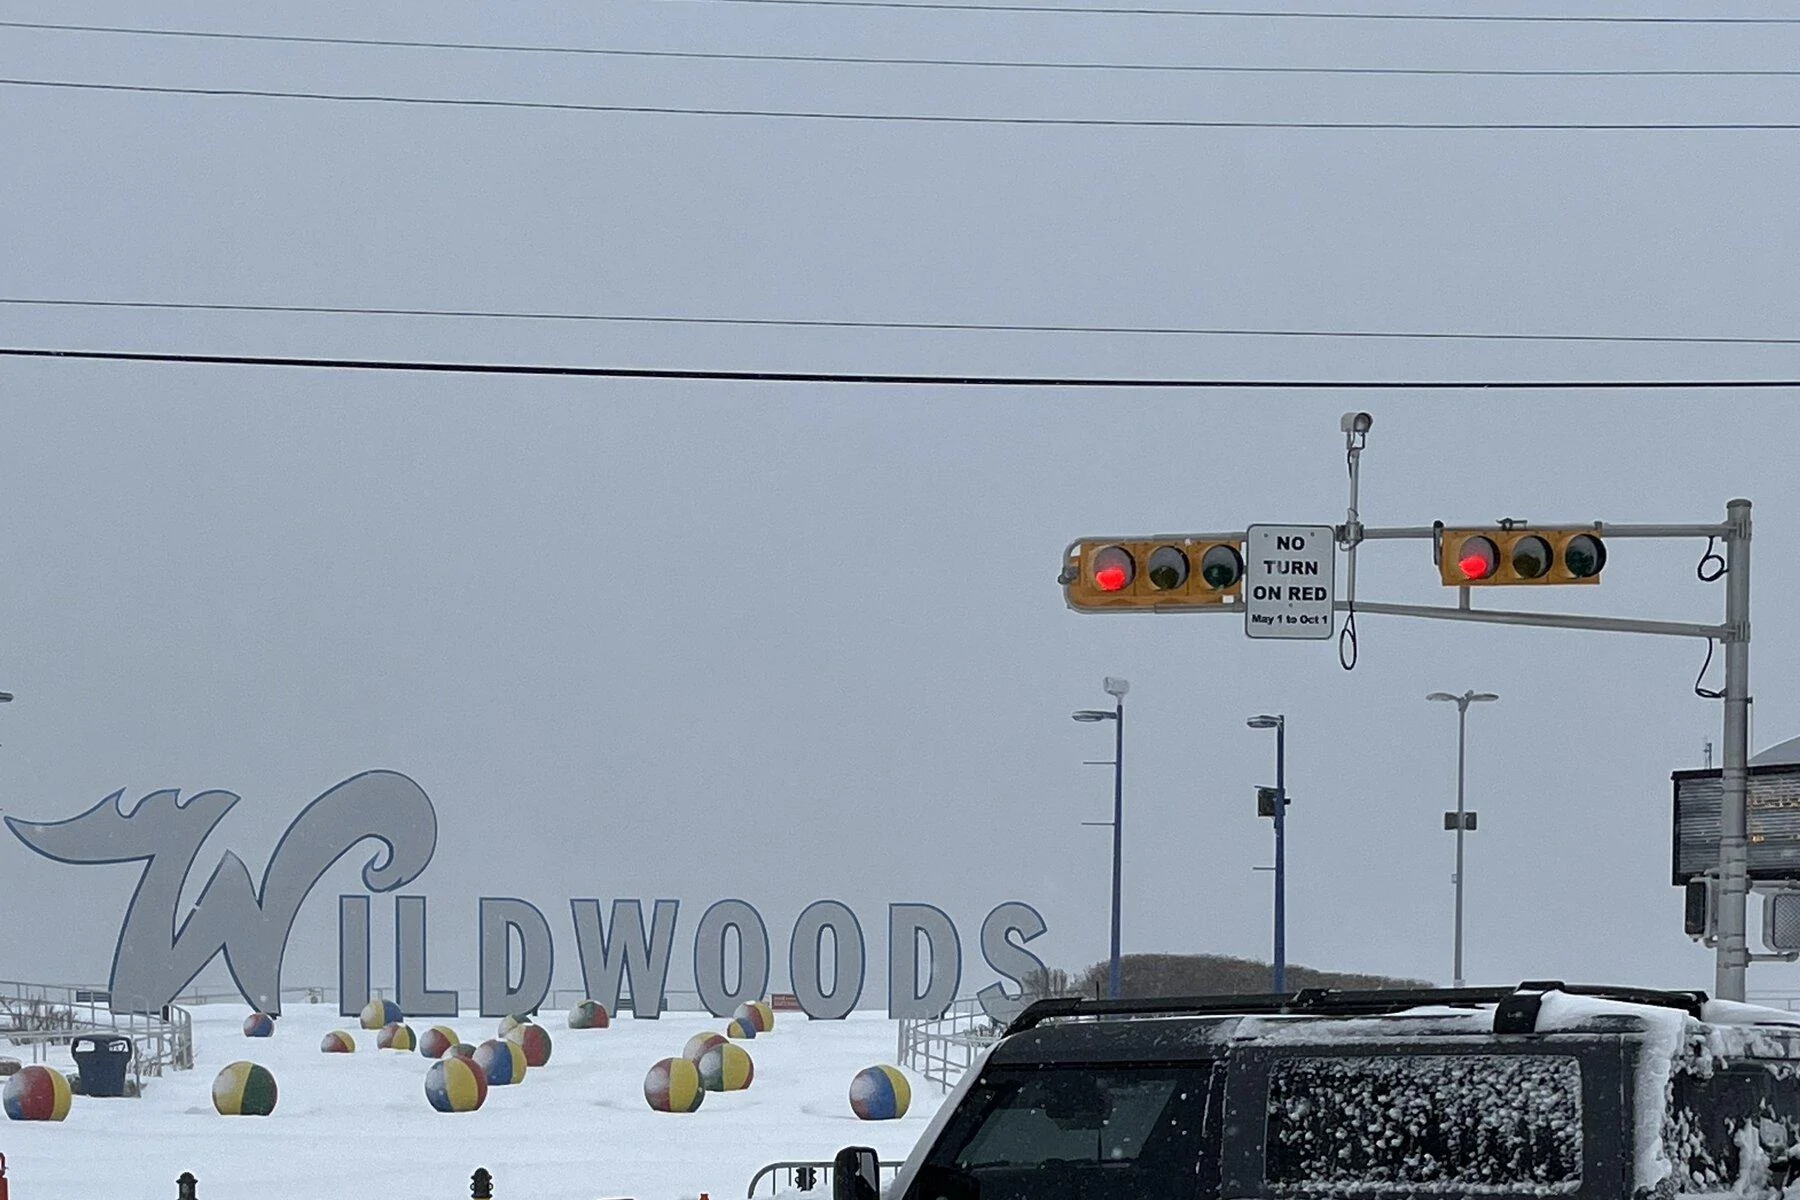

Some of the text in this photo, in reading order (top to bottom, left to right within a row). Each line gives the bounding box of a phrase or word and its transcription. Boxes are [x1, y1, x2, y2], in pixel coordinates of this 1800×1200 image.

[1276, 536, 1305, 551] NO
[1263, 560, 1318, 575] TURN
[1253, 586, 1327, 601] ON RED
[1251, 614, 1328, 625] May 1 to Oct 1
[4, 770, 1048, 1025] WILDWOODS
